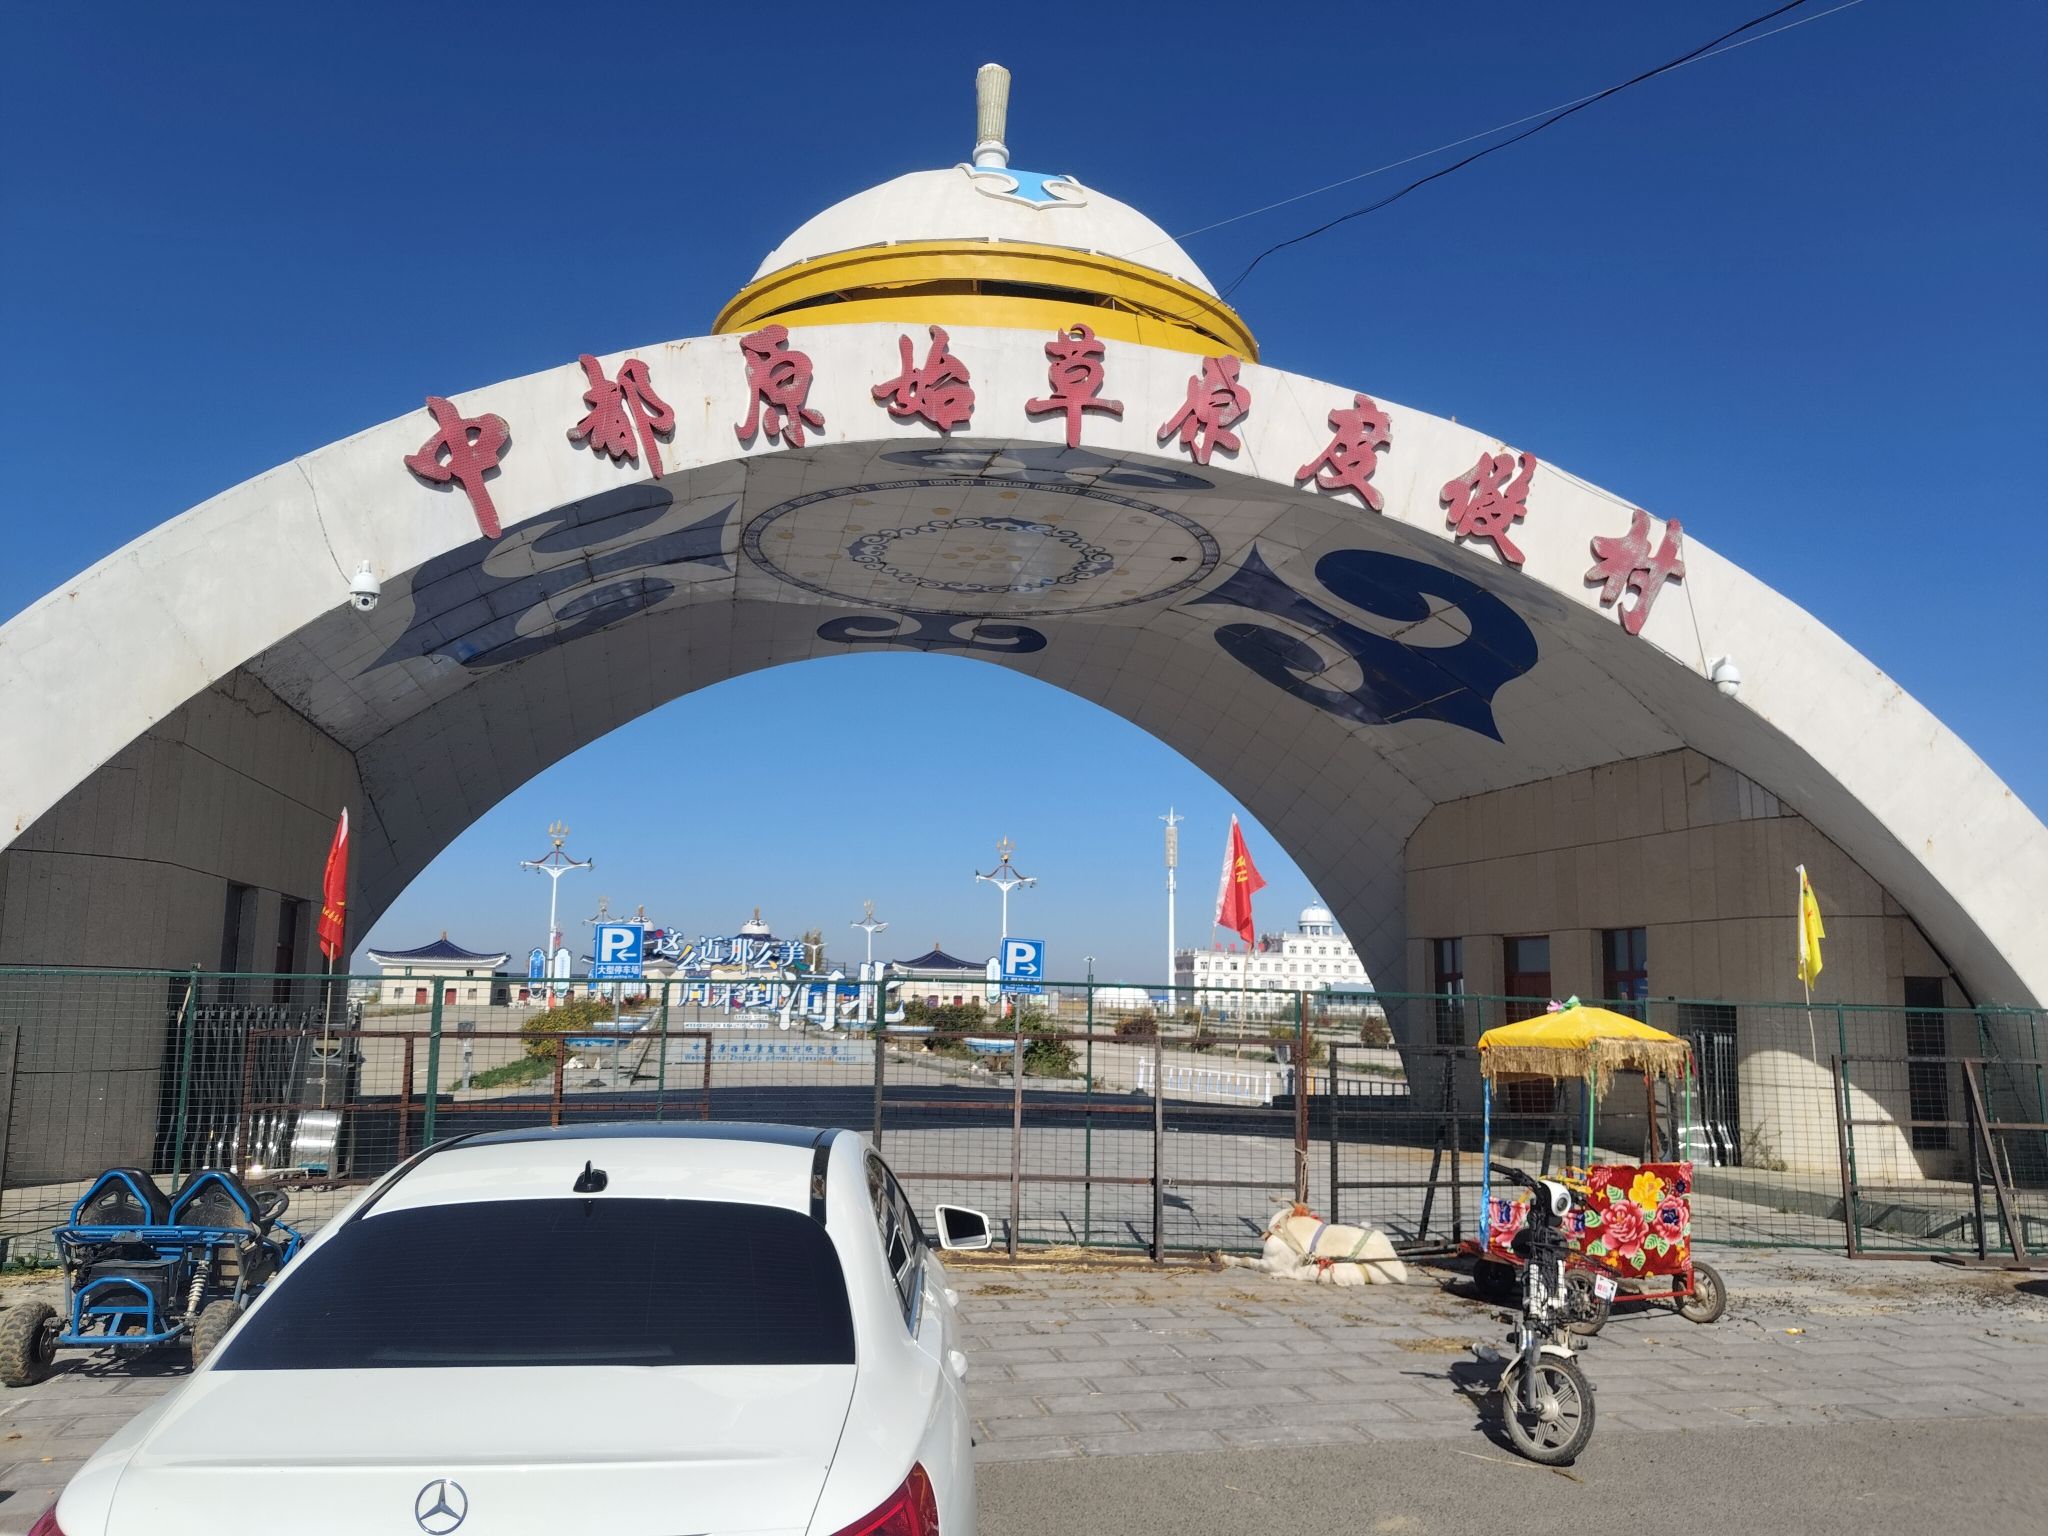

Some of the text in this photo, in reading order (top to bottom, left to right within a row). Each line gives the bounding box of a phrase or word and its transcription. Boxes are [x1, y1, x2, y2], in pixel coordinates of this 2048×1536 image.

[404, 324, 1685, 636] 中都原始草原度假村
[601, 928, 634, 962] P
[652, 927, 806, 974] 这么近那么美
[1005, 941, 1036, 974] P
[597, 965, 640, 975] 大型停车场
